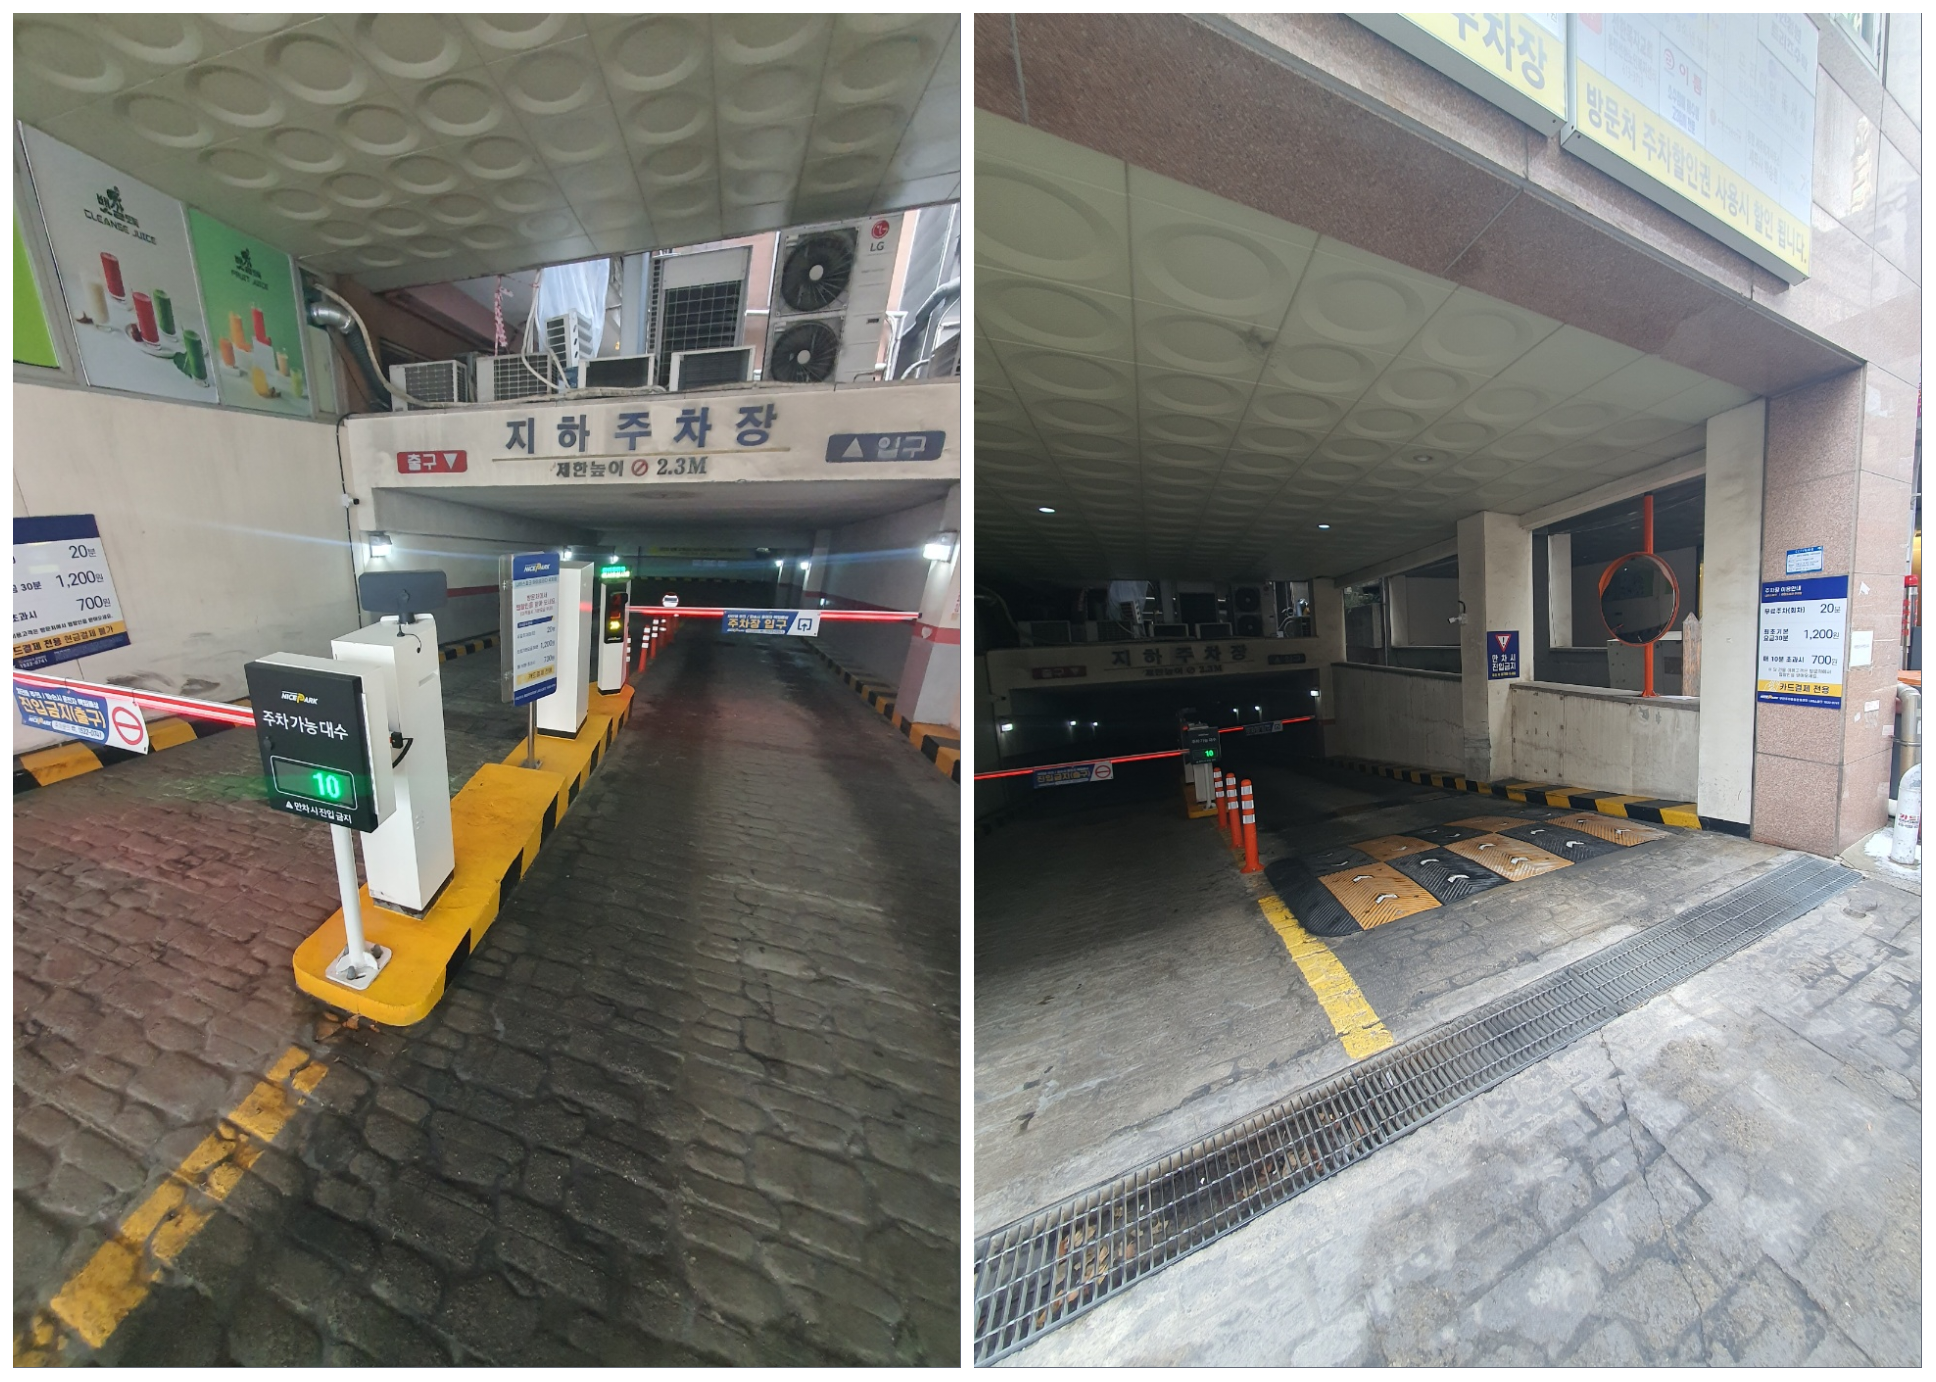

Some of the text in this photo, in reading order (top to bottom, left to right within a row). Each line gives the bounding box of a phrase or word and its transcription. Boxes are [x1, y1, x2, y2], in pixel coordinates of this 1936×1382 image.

[1586, 82, 1636, 151] 방문처
[1642, 122, 1711, 198] 주차할인권
[1715, 176, 1749, 225] 사용시
[1754, 203, 1773, 241] 할인
[84, 208, 130, 235] CLEANSE
[132, 229, 157, 245] JUICE
[869, 241, 885, 252] LG
[877, 436, 926, 458] 입구
[407, 454, 437, 470] 출구
[556, 456, 708, 478] 제한높이 2.3M
[68, 544, 97, 559] 20분
[21, 581, 43, 592] 30분
[55, 570, 104, 588] 1,200원
[1780, 584, 1802, 593] 이용안내
[76, 595, 112, 611] 700원
[1820, 603, 1841, 614] 20분
[728, 618, 787, 629] 주차장 입구
[44, 637, 62, 649] 전용
[64, 629, 96, 643] 현금결제
[1803, 629, 1840, 640] 1,200원
[1492, 662, 1516, 671] 진입금지
[1811, 654, 1838, 667] 700원
[1779, 682, 1830, 694] 카드결제 전용
[281, 690, 318, 704] NICEPARK
[18, 696, 106, 729] 진입금지(출구)
[263, 710, 348, 740] 주차 가능 대수
[1204, 749, 1214, 757] 10
[313, 772, 340, 799] 10
[319, 808, 334, 819] 진입
[335, 812, 352, 824] 금지
